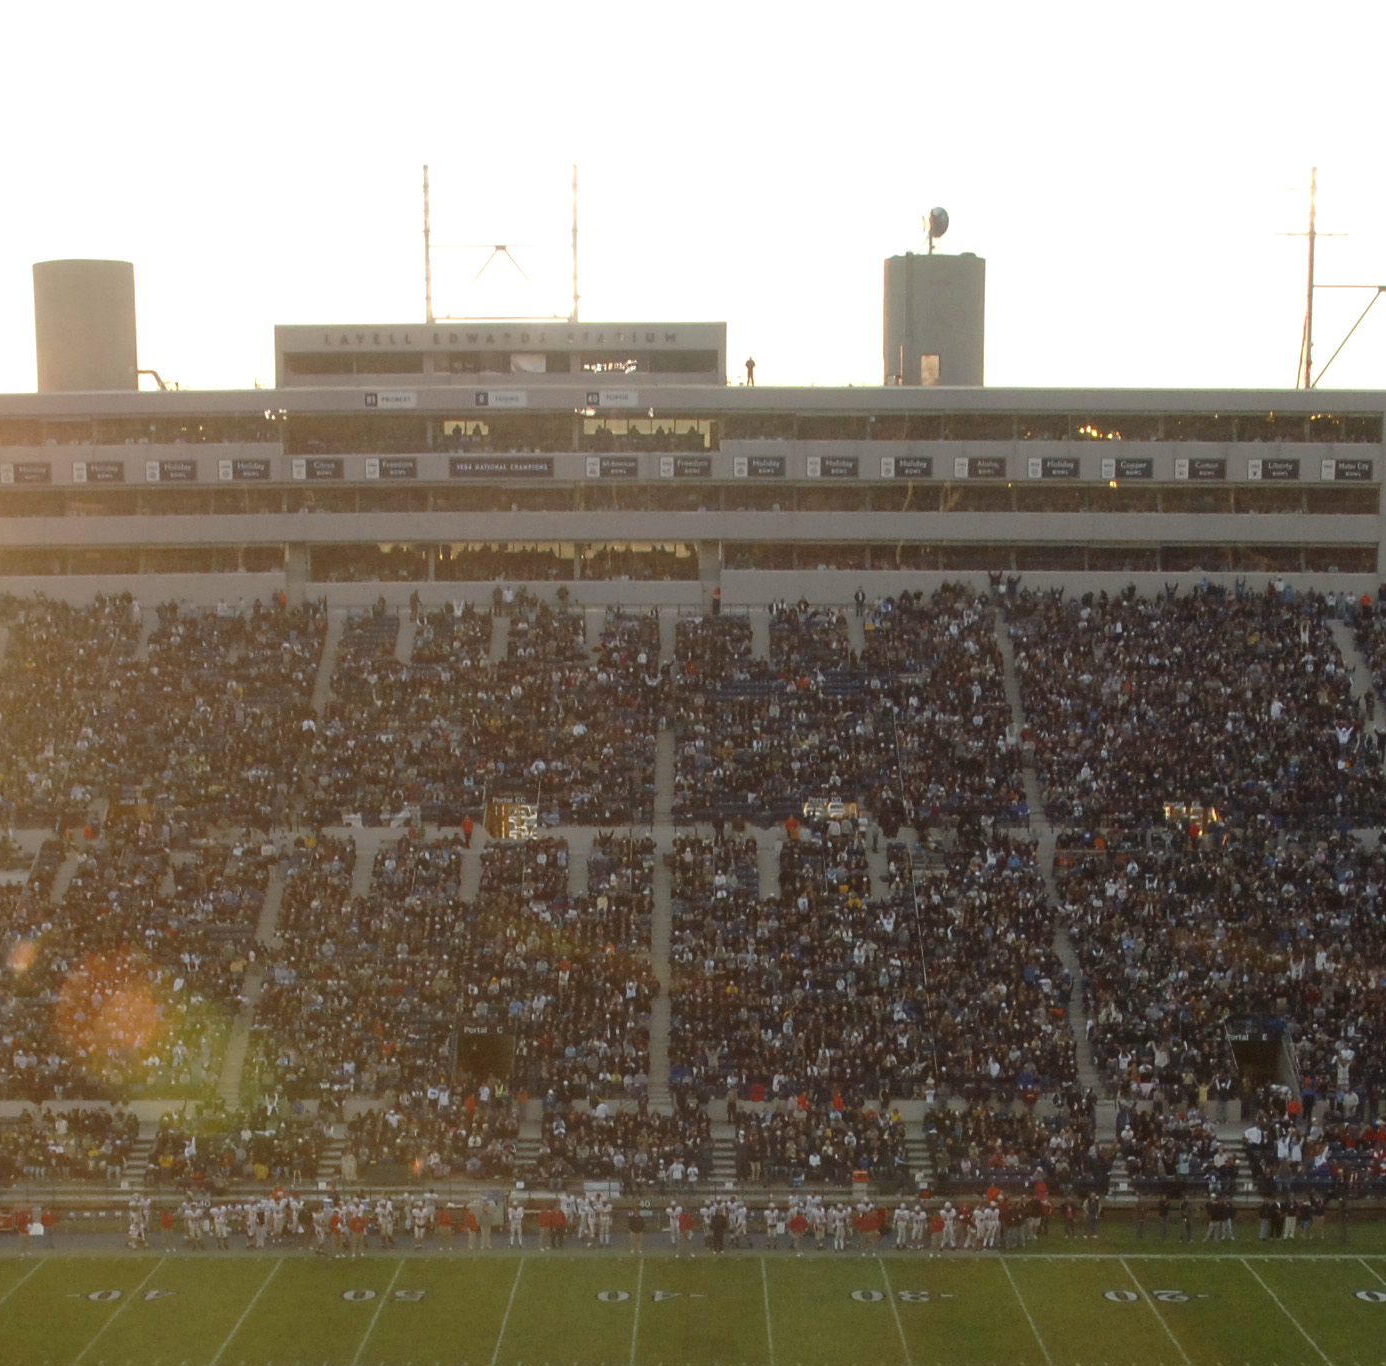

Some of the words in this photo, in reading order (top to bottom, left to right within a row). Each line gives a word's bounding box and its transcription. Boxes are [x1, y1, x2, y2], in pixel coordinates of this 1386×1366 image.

[324, 333, 412, 346] LAVELL
[91, 464, 118, 473] Holiday
[164, 464, 191, 473] Holiday
[237, 462, 264, 471] Holiday
[753, 459, 780, 469] Holiday
[826, 459, 853, 469] Holiday
[900, 459, 927, 469] Holiday
[1047, 460, 1074, 469] Holiday
[1268, 461, 1292, 470] Liberty
[638, 1200, 651, 1208] 40
